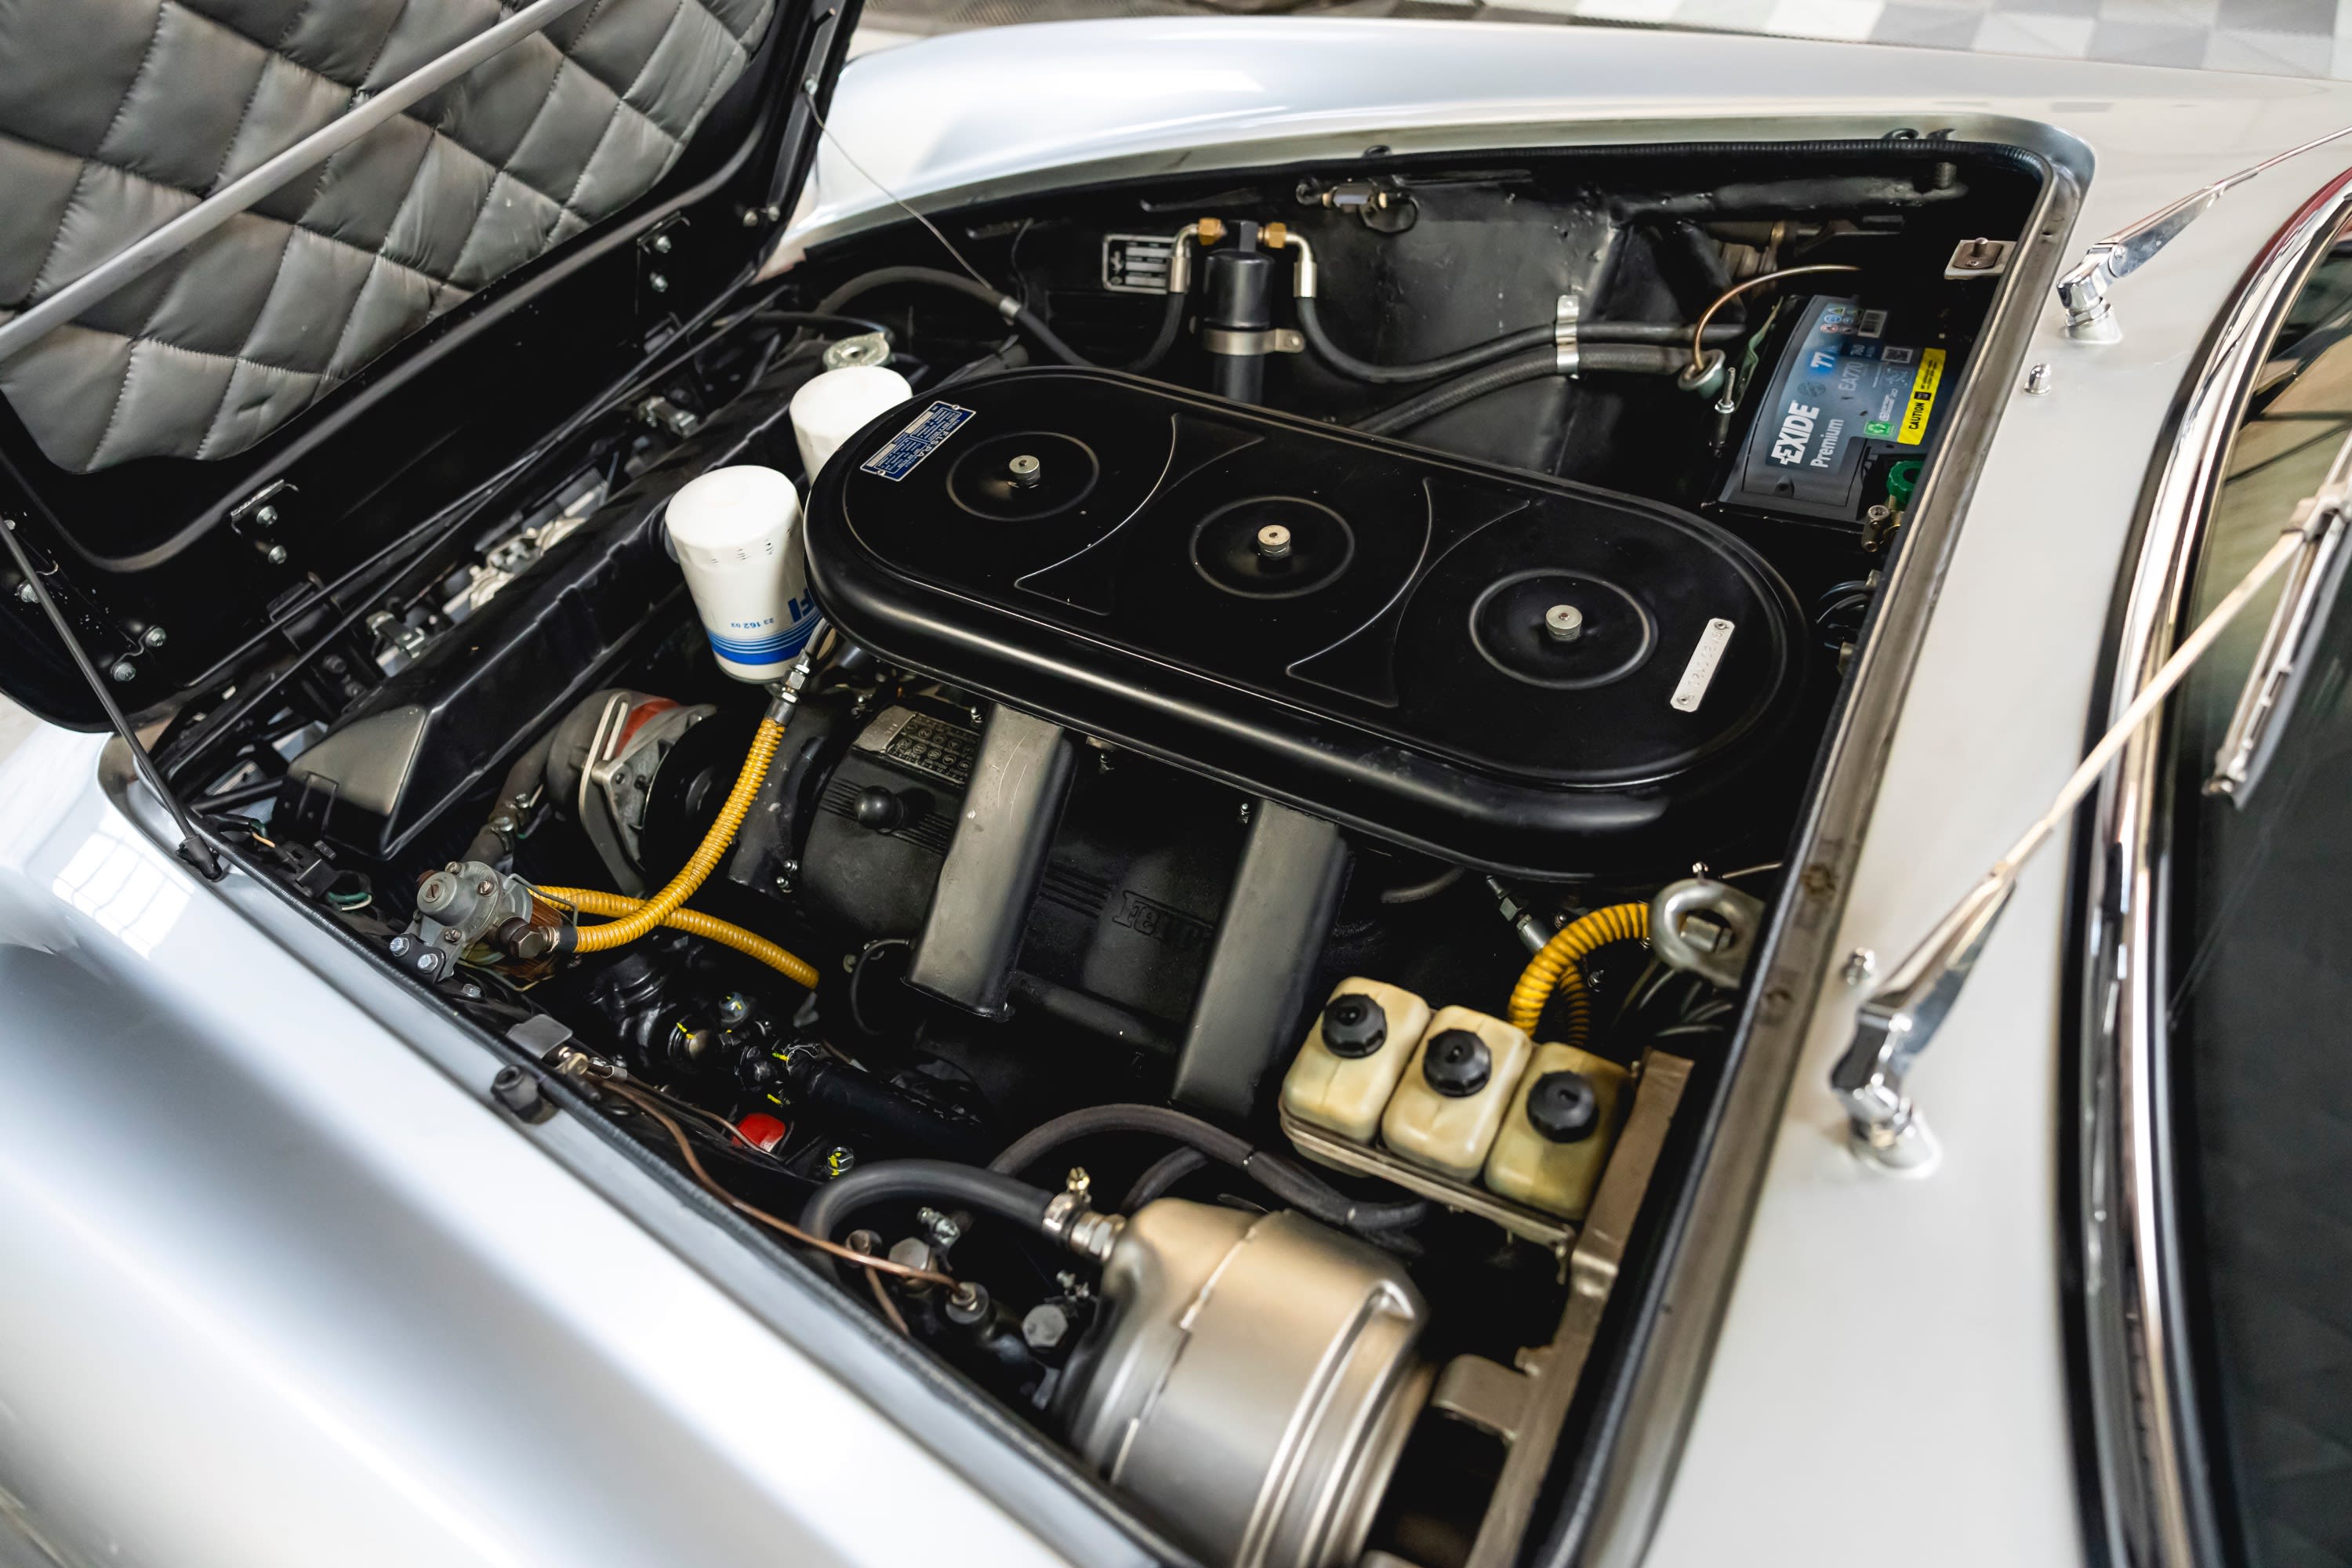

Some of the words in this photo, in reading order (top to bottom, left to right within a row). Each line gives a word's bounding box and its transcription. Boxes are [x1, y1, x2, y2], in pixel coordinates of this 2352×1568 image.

[1811, 350, 1835, 368] 77
[1838, 361, 1864, 391] EA770
[1908, 402, 1926, 430] CAUTION
[1770, 400, 1820, 466] EXIDE
[1810, 419, 1844, 468] Premium
